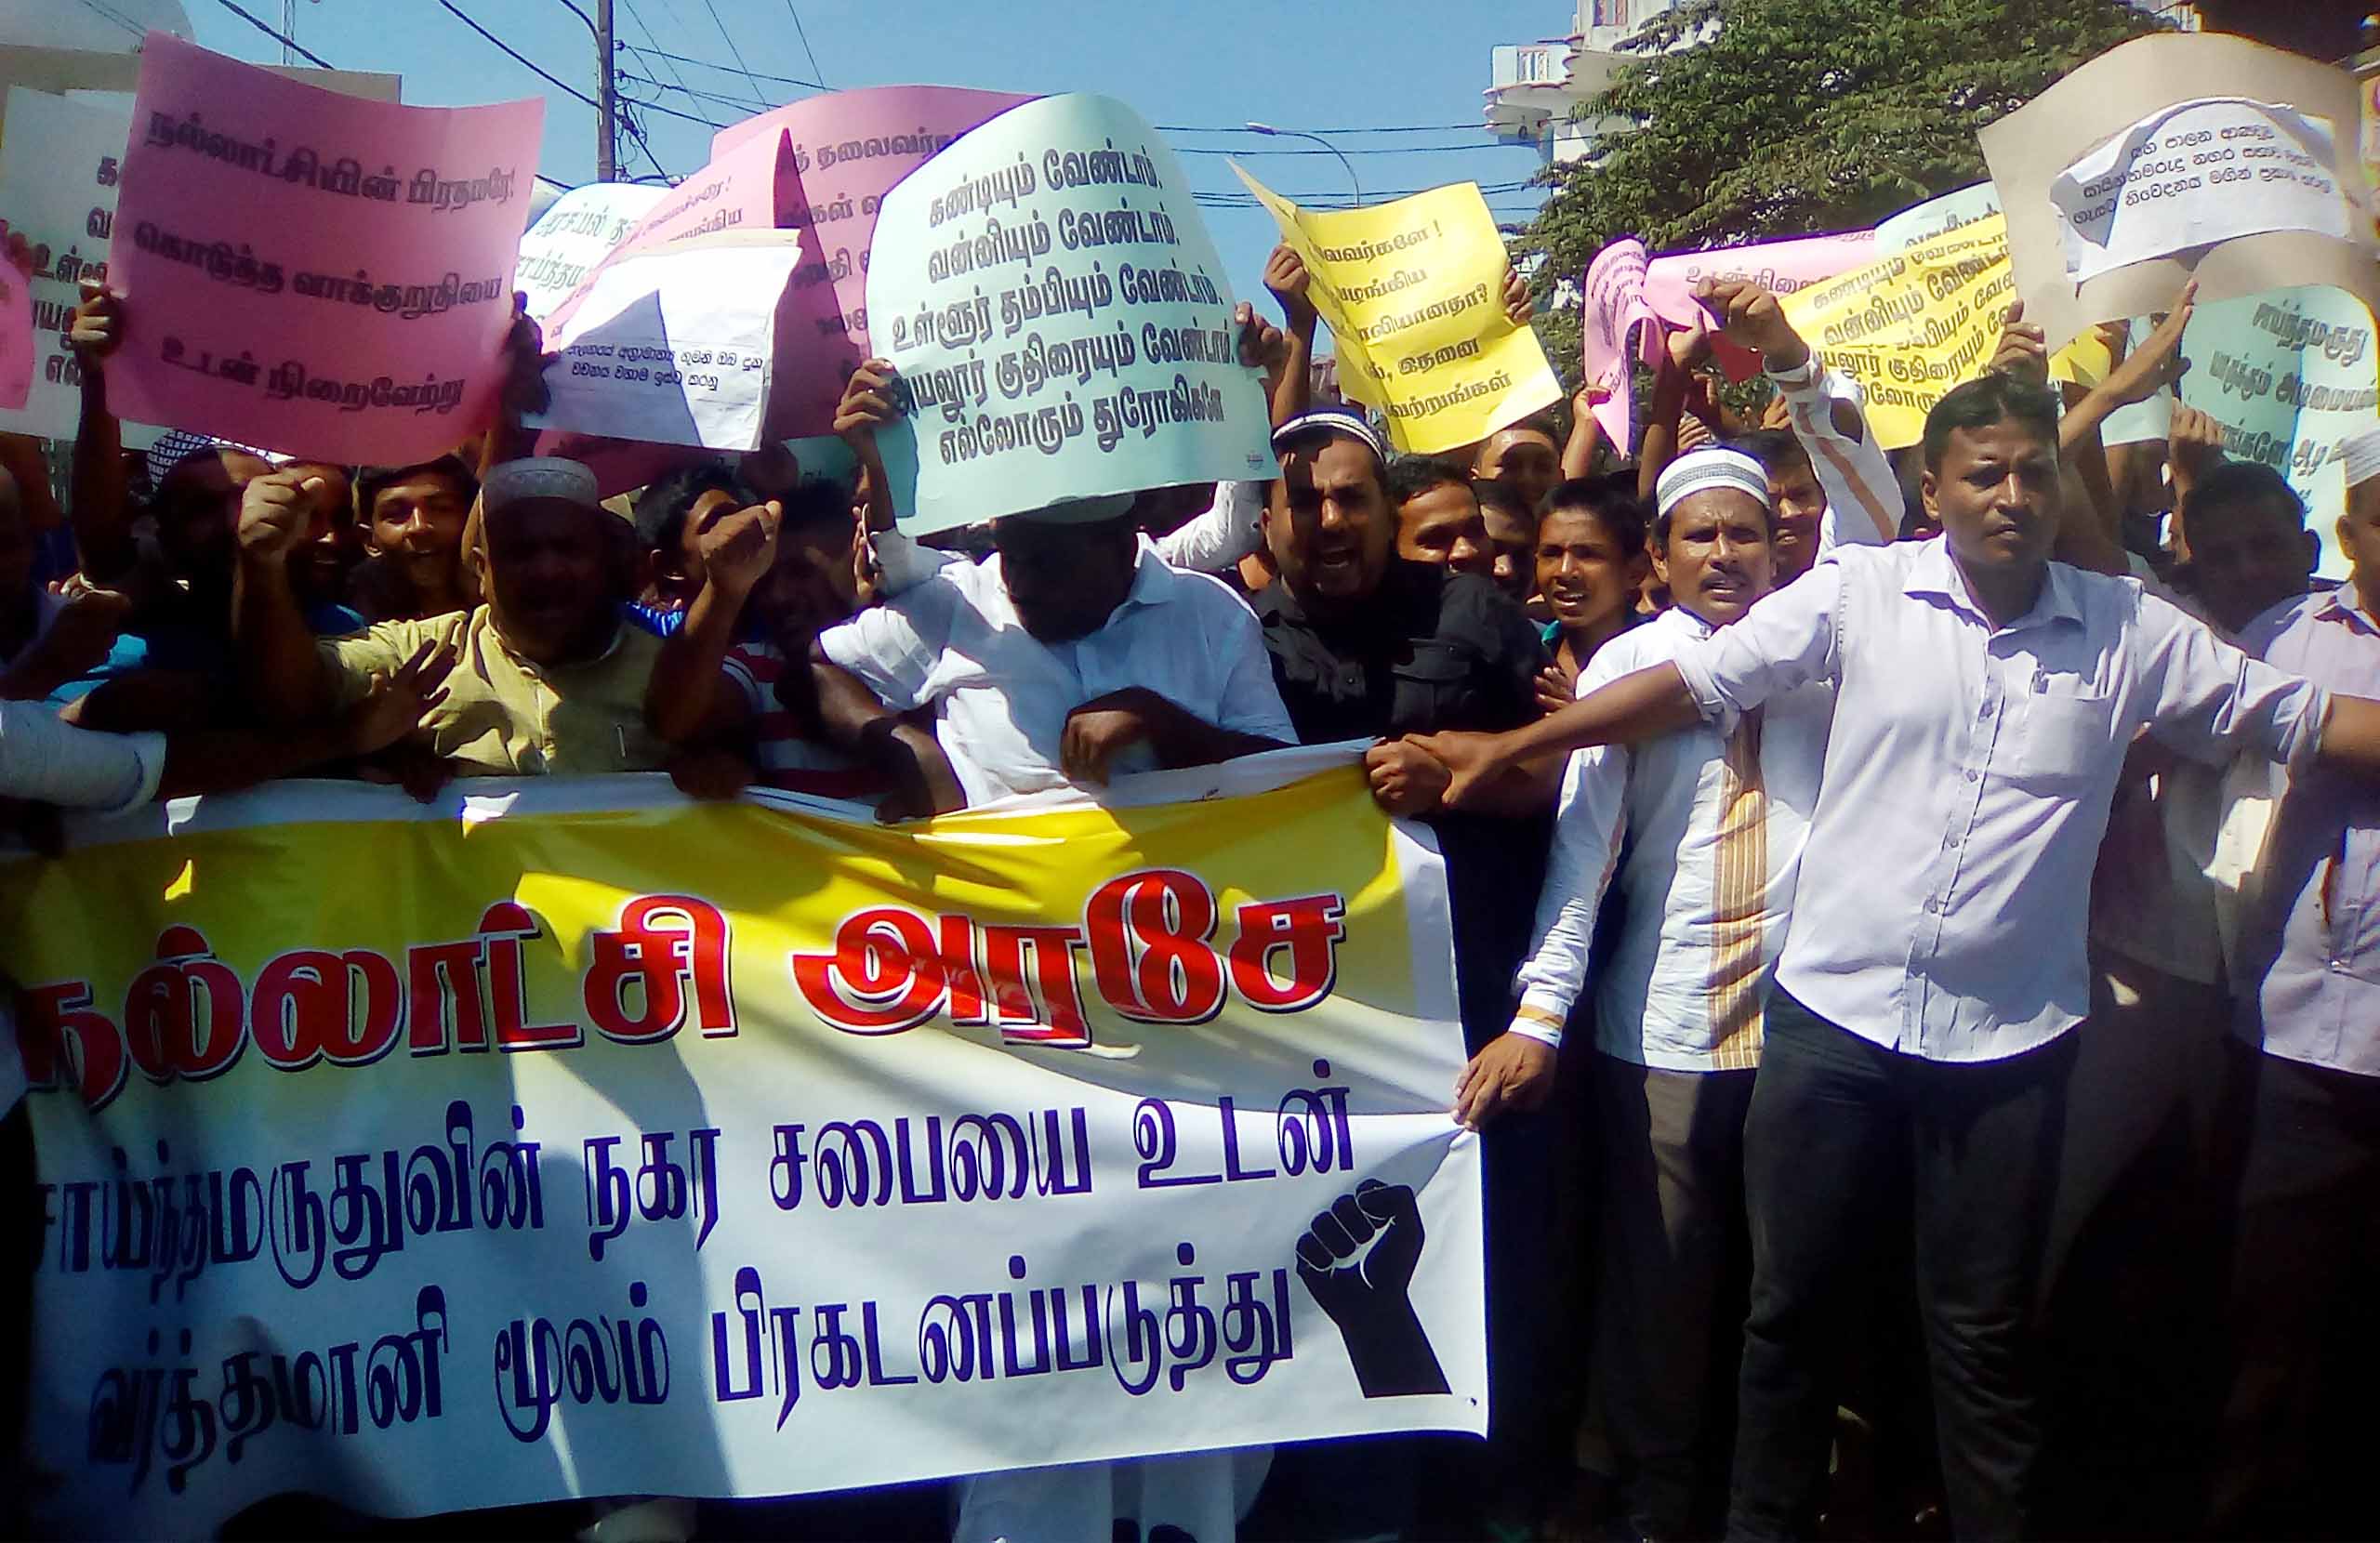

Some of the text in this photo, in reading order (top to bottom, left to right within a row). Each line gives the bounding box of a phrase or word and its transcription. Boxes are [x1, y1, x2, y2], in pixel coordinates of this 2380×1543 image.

[930, 152, 1037, 229] கண்டியும்
[134, 221, 284, 294] கொடுத்த
[928, 210, 1051, 284] வன்னியும்
[892, 284, 993, 352] உள்ளூர்
[1000, 261, 1113, 332] தம்பியும்
[161, 335, 260, 386] உடன்
[997, 320, 1136, 399] குதிரையும்
[939, 391, 1084, 468] எல்லோரும்
[16, 867, 1347, 1112] நல்லாட்சி அரசே
[583, 1125, 722, 1262] நகர
[768, 1106, 1093, 1211] சபையை
[1132, 1057, 1355, 1191] உடன்
[86, 1241, 1295, 1500] வர்த்தமானி மூலம் பிரகடனப்படுத்து
